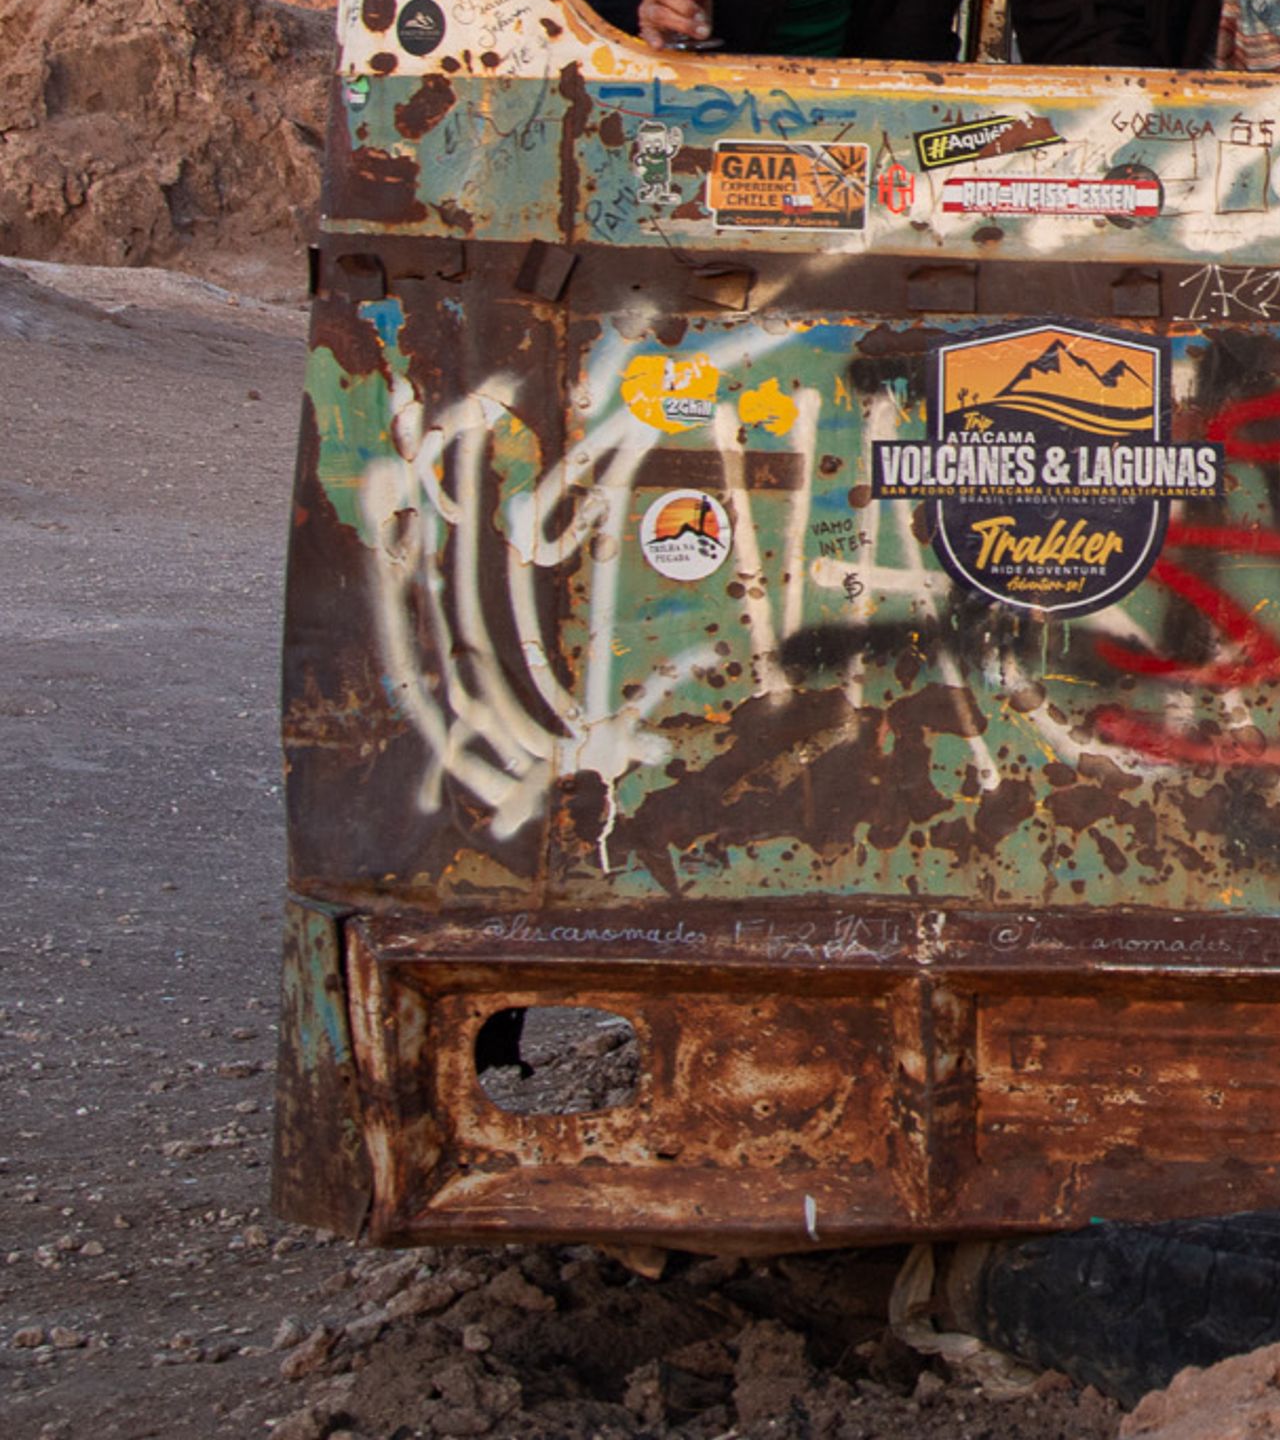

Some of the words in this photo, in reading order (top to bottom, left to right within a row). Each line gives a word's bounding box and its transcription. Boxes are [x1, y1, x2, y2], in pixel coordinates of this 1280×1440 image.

[1111, 111, 1216, 138] GOENAGA
[721, 155, 797, 180] GAIA
[726, 194, 777, 207] CHILE
[1078, 183, 1137, 211] ESSEN
[964, 412, 995, 433] Trip
[946, 431, 1037, 444] ATACAMA
[880, 445, 1036, 487] VOLCANES
[1041, 445, 1071, 486] &
[1078, 446, 1217, 488] LAGUNAS
[880, 486, 907, 495] SAN
[911, 486, 955, 496] PEDRO
[959, 486, 975, 496] DE
[980, 486, 1042, 496] ATACAMA
[1055, 486, 1117, 497] LAGUNAS
[1121, 486, 1217, 497] ALTIPLANICAS
[959, 495, 1003, 505] BRASIL
[1015, 495, 1089, 505] ARGENTINA
[1098, 495, 1137, 505] CHILE
[811, 518, 854, 538] VAMO
[818, 531, 873, 558] INTER
[971, 515, 1123, 570] Trakker
[990, 565, 1023, 575] RIDE
[1026, 565, 1107, 576] ADVENTURE
